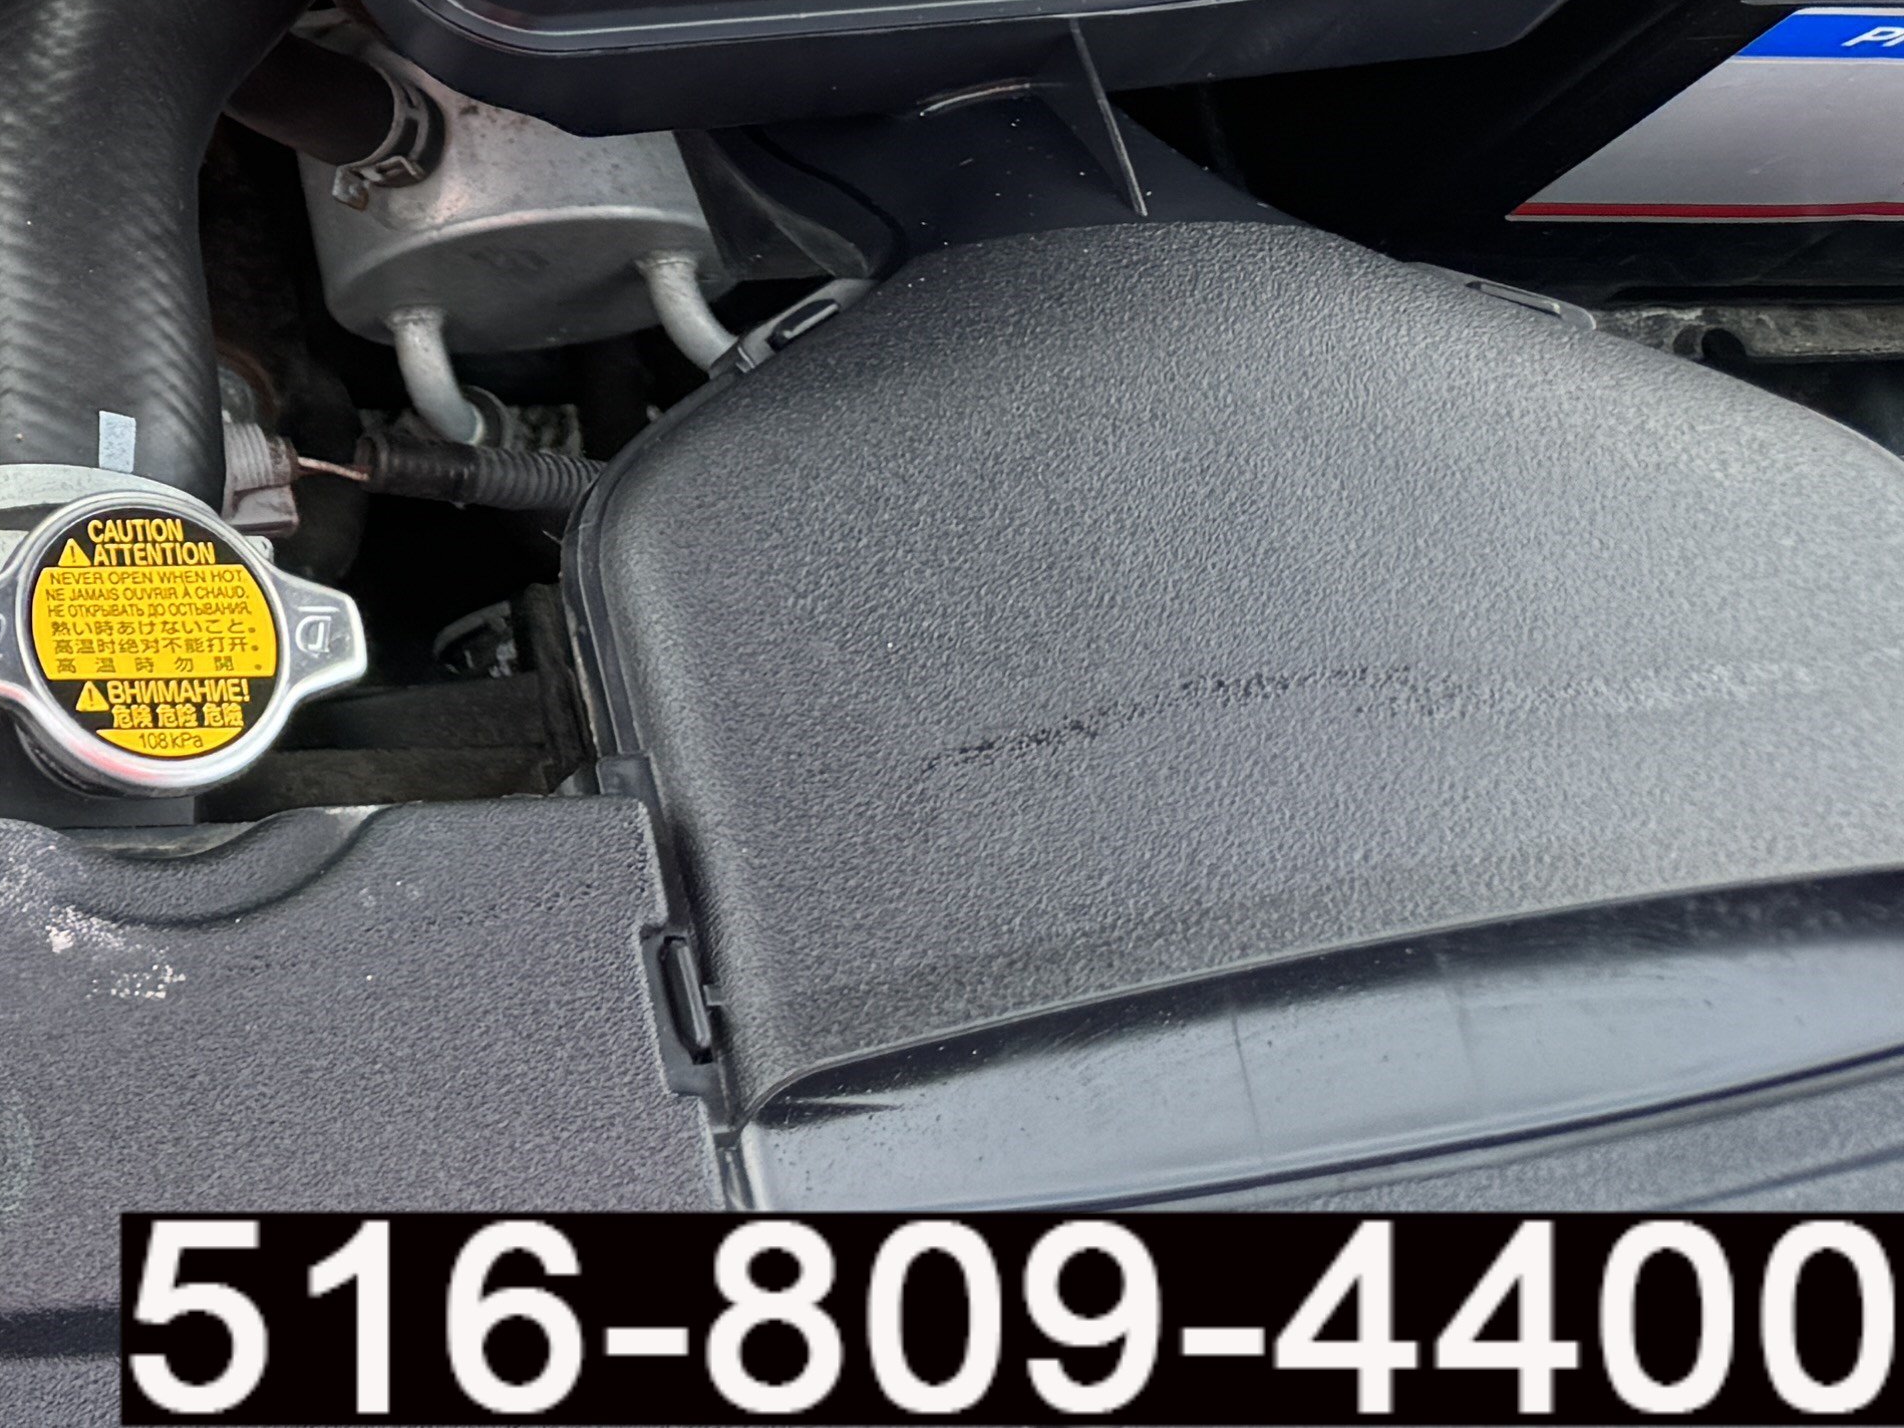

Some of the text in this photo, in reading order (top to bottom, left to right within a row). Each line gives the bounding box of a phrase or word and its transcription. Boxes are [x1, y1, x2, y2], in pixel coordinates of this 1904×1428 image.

[87, 518, 184, 543] CAUTION
[93, 541, 216, 566] ATTENTION
[49, 571, 104, 585] NEVER
[107, 570, 153, 585] OPEN
[158, 569, 206, 584] WHEN
[45, 589, 65, 602] NE
[68, 587, 120, 602] JAMAIS
[124, 587, 177, 601] OUVRIR
[194, 585, 250, 600] CHAUD.
[47, 605, 65, 618] НЕ
[68, 604, 145, 618] ОТКРЫВАТЬ
[147, 603, 166, 619] ДО
[50, 619, 257, 636] 熱い時あけないこと。
[106, 678, 251, 705] ВНИМАНИЕ!
